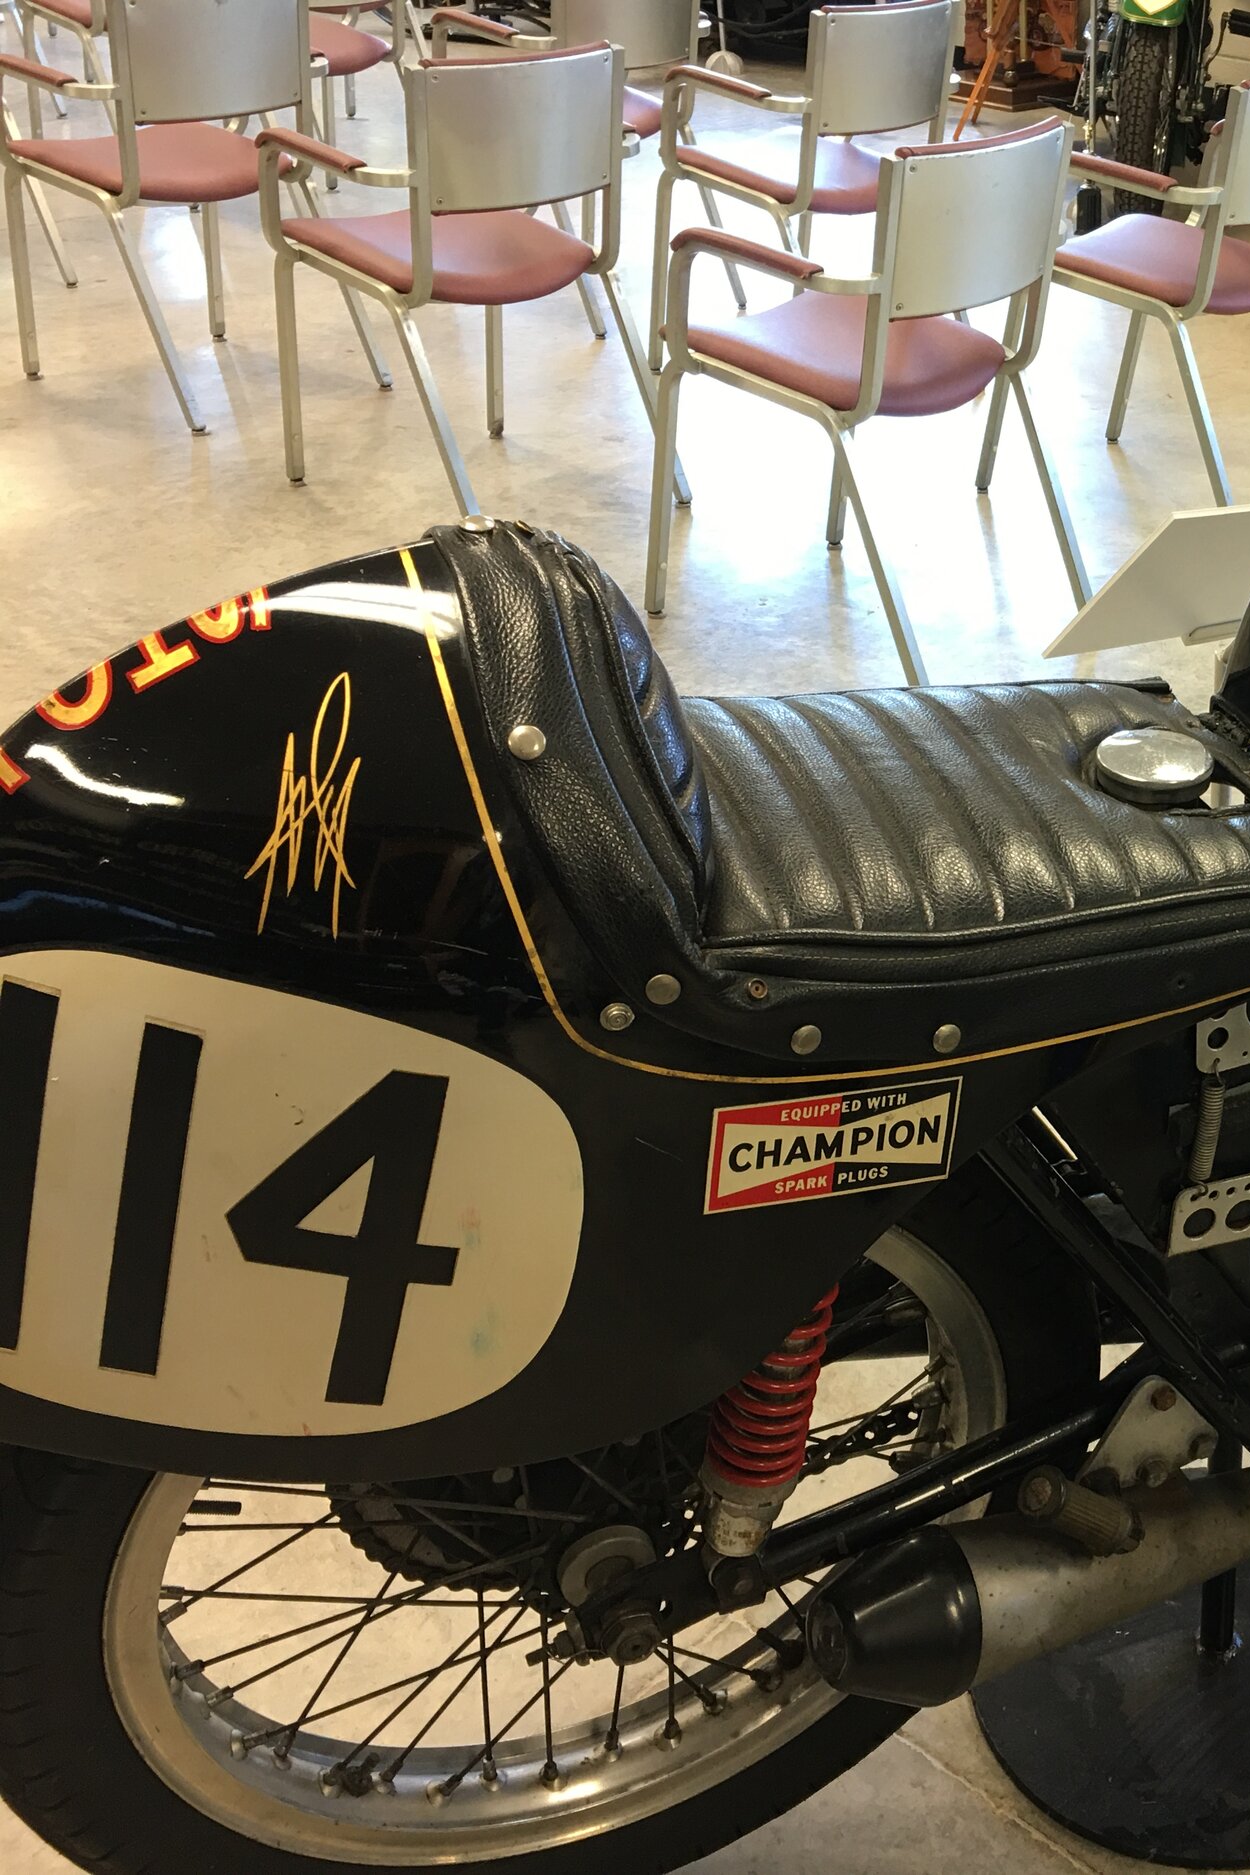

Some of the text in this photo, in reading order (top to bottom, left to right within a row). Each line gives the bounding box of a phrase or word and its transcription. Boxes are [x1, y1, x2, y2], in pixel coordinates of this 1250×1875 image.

[780, 1092, 907, 1122] EQUIPPED WITH
[728, 1114, 942, 1173] CHAMPION
[0, 978, 460, 1406] 114
[774, 1166, 889, 1194] SPARK PLUGS
